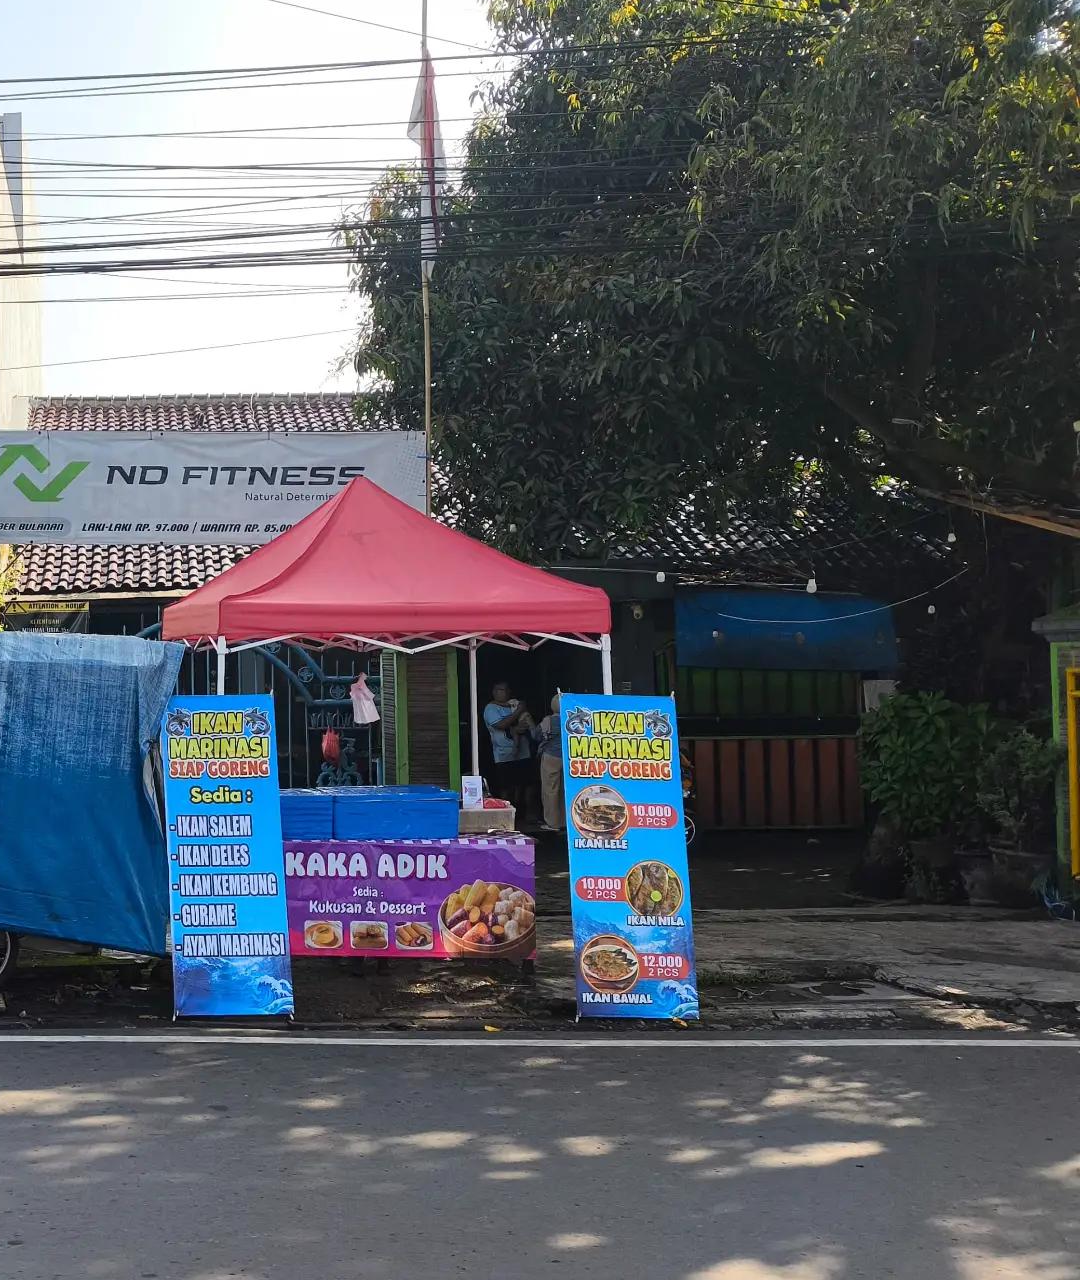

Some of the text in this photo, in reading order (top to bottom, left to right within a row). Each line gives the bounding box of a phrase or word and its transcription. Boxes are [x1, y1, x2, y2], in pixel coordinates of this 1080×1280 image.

[107, 465, 365, 486] ND FITNESS
[245, 492, 283, 501] Natural
[19, 523, 64, 531] BULANAN
[82, 523, 132, 532] LAKI-LAKI
[135, 523, 151, 532] RP.
[155, 523, 189, 532] 97.000
[200, 523, 241, 533] WANITA
[244, 524, 260, 533] RP.
[192, 711, 244, 735] IKAN
[592, 711, 644, 735] IKAN
[169, 736, 270, 760] MARINASI
[569, 736, 671, 761] MARINASI
[170, 760, 270, 778] SIAP GORENG
[570, 760, 672, 779] SIAP GORENG
[190, 785, 242, 803] Sedia
[631, 805, 672, 818] 10.000
[209, 815, 252, 837] SALEM
[638, 817, 668, 826] 2 PCS
[574, 838, 628, 850] IKAN LELE
[211, 844, 250, 866] DELES
[285, 852, 448, 879] KAKA ADIK
[212, 873, 278, 896] KEMBUNG
[581, 877, 622, 890] 10.000
[352, 886, 378, 897] Sedia
[587, 890, 617, 899] 2 PCS
[309, 900, 427, 915] Kukusan & Dessert
[627, 915, 685, 926] IKAN NILA
[220, 933, 286, 956] MARINASI
[642, 955, 683, 968] 12.000
[648, 967, 679, 977] 2 PCS
[582, 992, 654, 1004] IKAN BAWAL
